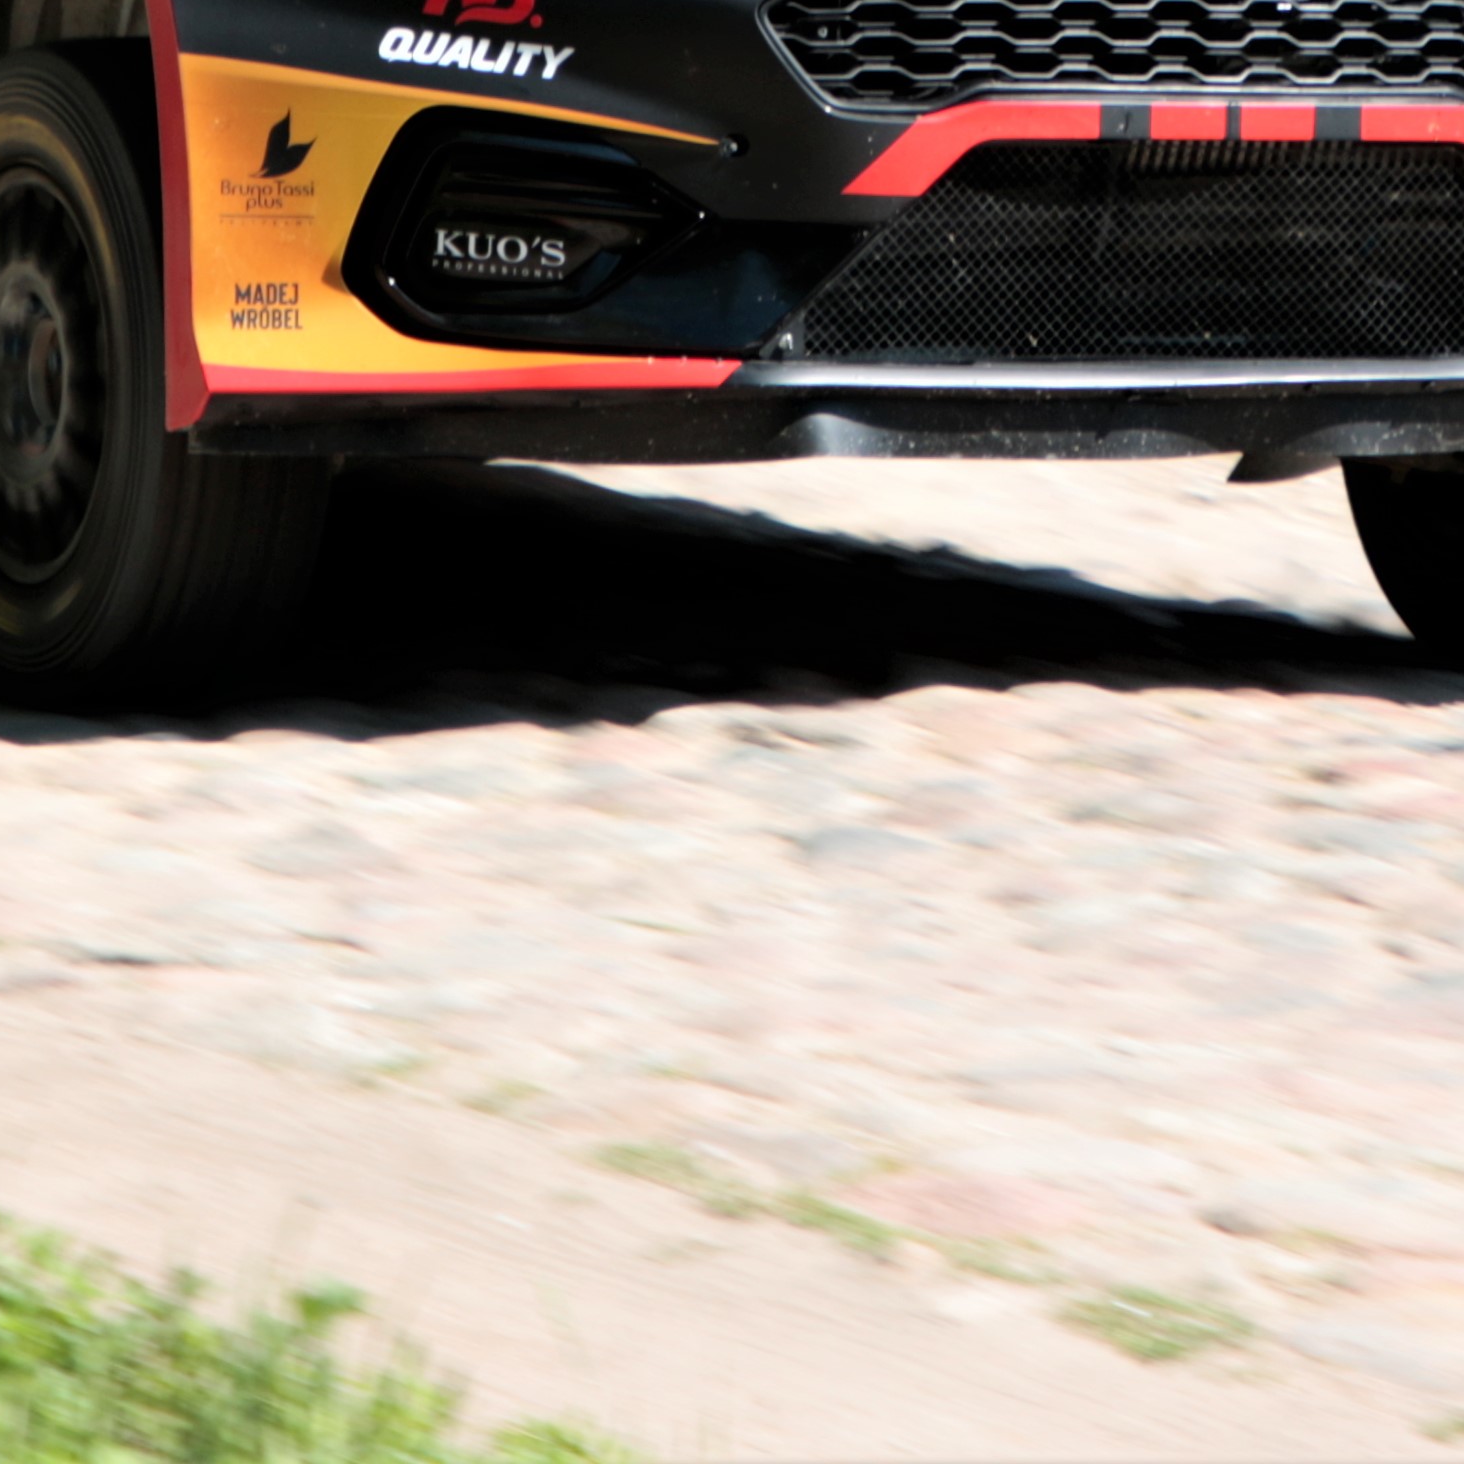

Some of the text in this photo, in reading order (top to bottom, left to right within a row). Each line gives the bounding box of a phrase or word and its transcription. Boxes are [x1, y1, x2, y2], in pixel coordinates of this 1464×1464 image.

[378, 27, 575, 80] QUALITY
[220, 179, 315, 198] Bruno Tassi
[245, 194, 283, 213] plus
[433, 228, 566, 268] KUO'S
[432, 258, 564, 280] PROFESSIONAL
[234, 282, 300, 306] MADEJ
[230, 304, 303, 330] WRÓBEL
